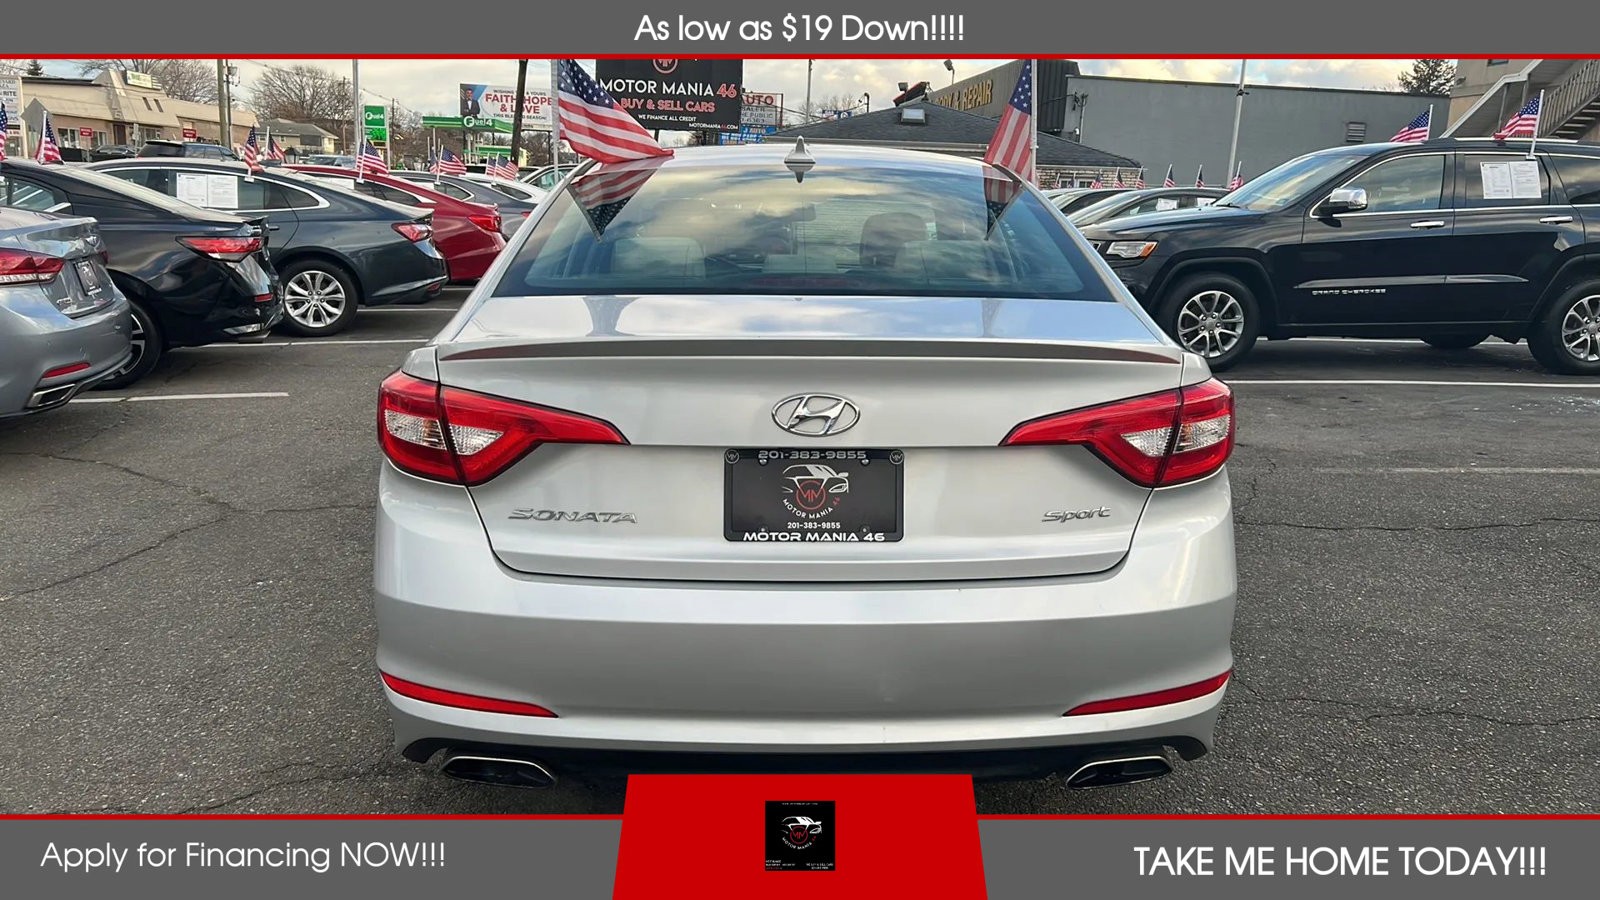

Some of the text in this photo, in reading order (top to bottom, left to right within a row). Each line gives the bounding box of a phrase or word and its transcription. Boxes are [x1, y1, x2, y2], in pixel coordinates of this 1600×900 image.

[599, 78, 737, 98] MOTOR MANIA 46
[962, 79, 993, 111] REPAIR
[485, 93, 552, 106] FAITH HOPE
[620, 97, 716, 113] BUY & SELL CARS
[500, 104, 540, 114] & LVE
[758, 450, 867, 460] 201-383-9855
[507, 508, 638, 524] SONATA
[782, 498, 807, 519] MOTOR
[808, 506, 834, 519] MANIA
[1041, 506, 1112, 524] Sport
[787, 521, 841, 529] 201-383-9855
[743, 531, 886, 542] MOTOR MANIA 46
